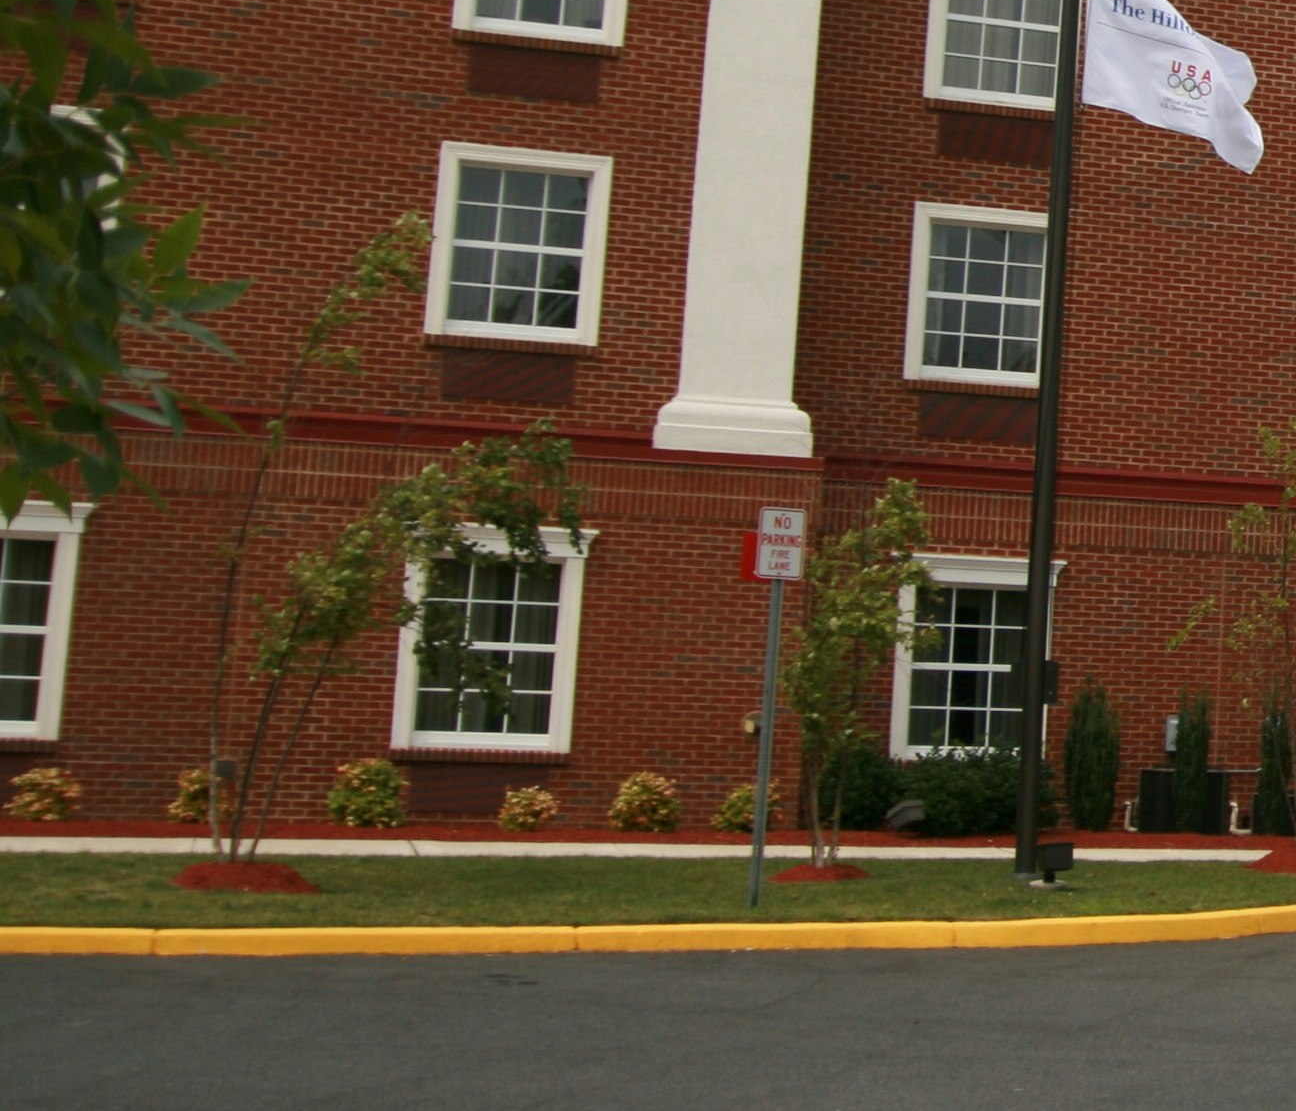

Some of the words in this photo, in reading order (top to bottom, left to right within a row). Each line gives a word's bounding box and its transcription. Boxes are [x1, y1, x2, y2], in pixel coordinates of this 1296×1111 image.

[774, 516, 792, 529] NO
[760, 533, 802, 548] PARKING
[770, 549, 790, 559] FIRE
[768, 561, 791, 571] LANE
